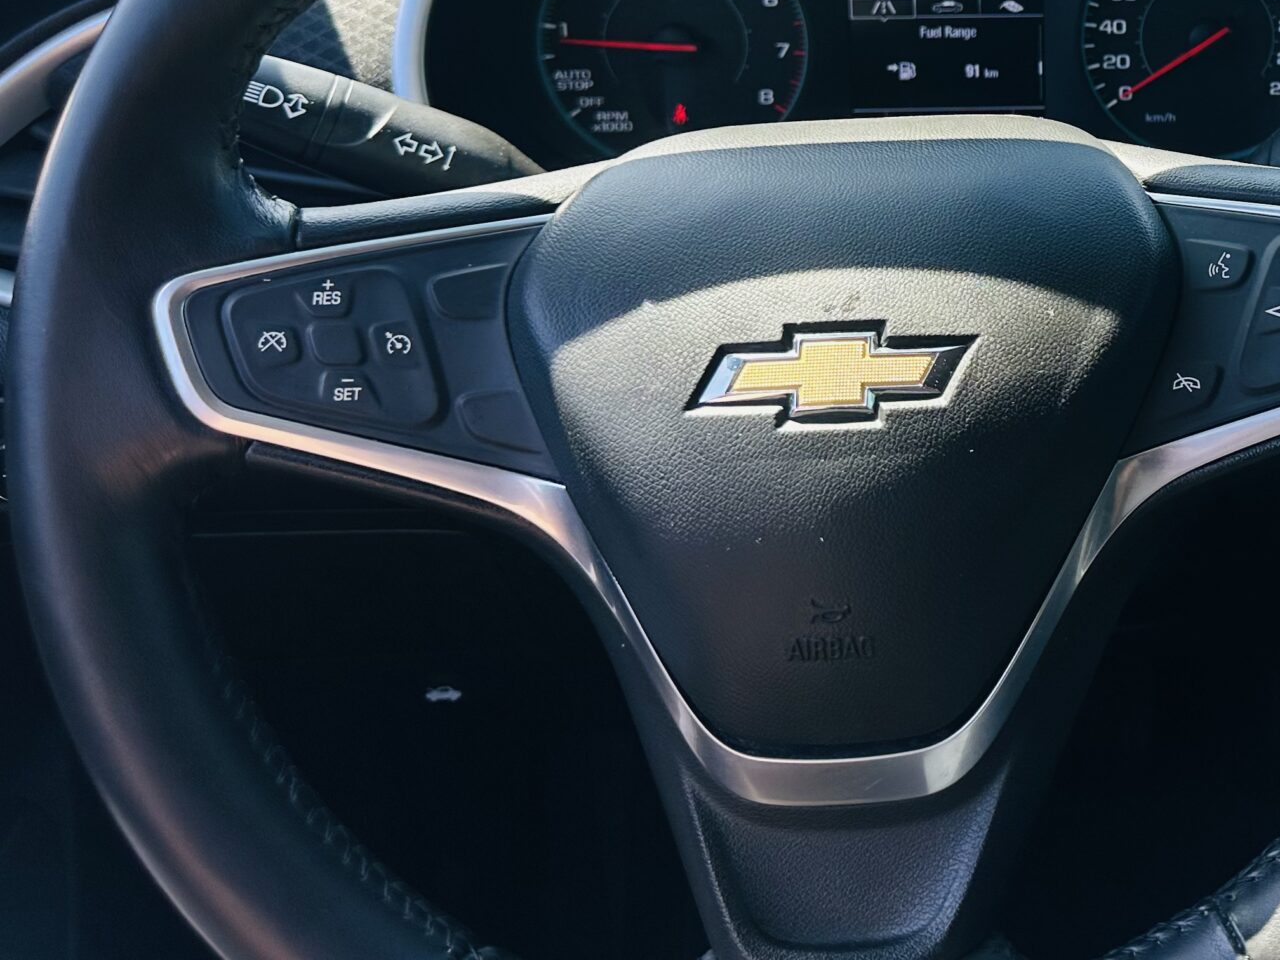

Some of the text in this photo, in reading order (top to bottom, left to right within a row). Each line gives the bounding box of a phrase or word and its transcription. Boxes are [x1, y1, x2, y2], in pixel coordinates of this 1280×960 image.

[559, 22, 568, 37] 1
[919, 25, 977, 40] Fuel Range
[1100, 20, 1127, 34] 40
[776, 44, 790, 57] 7
[1103, 55, 1130, 69] 20
[554, 69, 592, 81] AUTO
[965, 63, 999, 79] 91 km
[556, 80, 594, 91] STOP
[758, 90, 774, 104] 8
[1118, 86, 1133, 100] 0
[596, 111, 629, 121] RPM
[1145, 113, 1176, 122] km/h
[312, 291, 342, 305] RES
[333, 387, 362, 402] SET
[787, 637, 874, 662] AIRBAG
